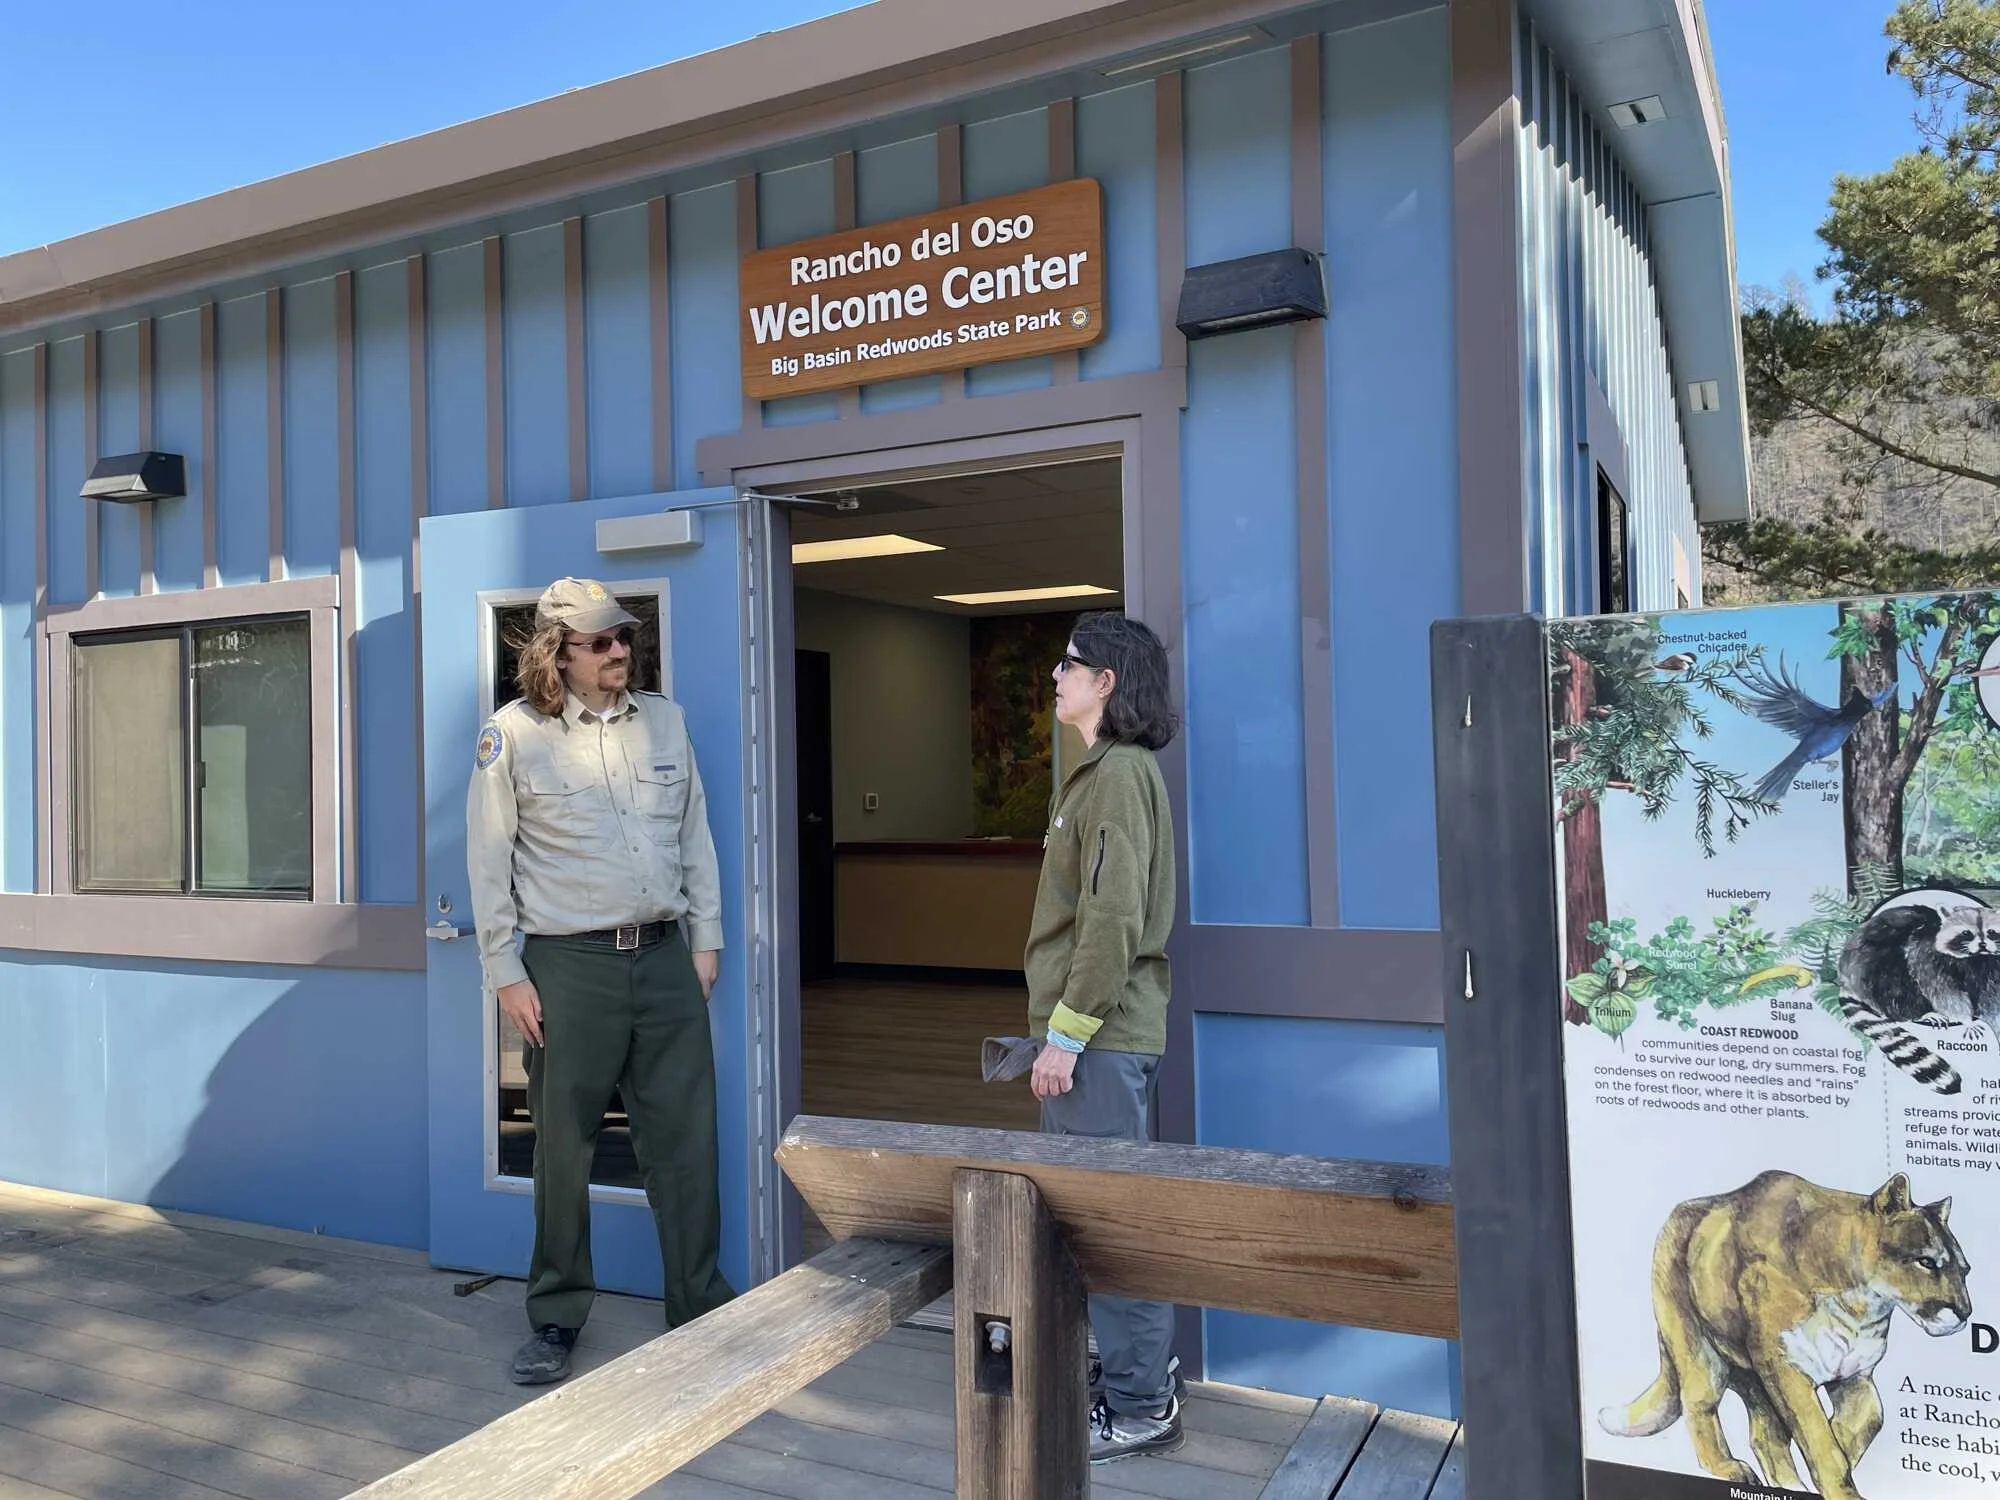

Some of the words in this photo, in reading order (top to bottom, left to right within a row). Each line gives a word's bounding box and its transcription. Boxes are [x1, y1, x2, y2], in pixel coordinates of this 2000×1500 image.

[790, 242, 901, 286] Rancho
[911, 222, 960, 261] del
[971, 214, 1034, 248] Oso
[750, 283, 928, 345] Welcome
[942, 250, 1087, 309] Center
[771, 357, 798, 376] Big
[804, 347, 851, 370] Basin
[857, 330, 952, 361] Redwoods
[957, 320, 1010, 344] State
[1015, 308, 1061, 333] Park
[1657, 629, 1747, 645] Chestnut-backed
[1697, 643, 1748, 653] Chicadee
[1793, 779, 1839, 790] Steller's
[1821, 791, 1839, 803] Jay
[1706, 888, 1771, 902] Huckleberry
[1648, 946, 1696, 959] Redwood
[1770, 999, 1813, 1010] Banana
[1771, 1011, 1796, 1023] Slug
[1700, 1026, 1737, 1037] COAST
[1740, 1028, 1799, 1040] REDWOOD
[1642, 1039, 1719, 1052] communities
[1722, 1042, 1769, 1056] depend
[1773, 1046, 1789, 1055] on
[1792, 1047, 1839, 1058] coastal
[1842, 1048, 1863, 1061] fog
[1937, 1040, 1988, 1052] Raccoon
[1635, 1053, 1646, 1062] to
[1649, 1054, 1692, 1065] survive
[1695, 1057, 1715, 1066] our
[1719, 1057, 1748, 1070] long,
[1752, 1059, 1772, 1071] dry
[1775, 1062, 1839, 1074] summers.
[1842, 1063, 1866, 1077] Fog
[1594, 1065, 1657, 1078] condenses
[1660, 1070, 1675, 1079] on
[1679, 1071, 1730, 1082] redwood
[1735, 1074, 1784, 1086] needles
[1787, 1078, 1811, 1088] and
[1981, 1076, 2000, 1088] ha
[1595, 1081, 1609, 1089] on
[1613, 1080, 1631, 1091] the
[1635, 1082, 1669, 1094] forest
[1671, 1084, 1702, 1097] floor,
[1705, 1087, 1743, 1099] where
[1746, 1089, 1754, 1099] it
[1758, 1090, 1768, 1100] is
[1772, 1090, 1831, 1105] absorbed
[1835, 1094, 1850, 1108] by
[1972, 1094, 1986, 1104] of
[1990, 1094, 2000, 1104] ri
[1595, 1095, 1625, 1106] roots
[1627, 1096, 1639, 1106] of
[1642, 1098, 1700, 1111] redwoods
[1703, 1102, 1726, 1112] and
[1730, 1104, 1762, 1115] other
[1766, 1107, 1809, 1119] plants.
[1904, 1107, 1959, 1119] streams
[1905, 1123, 1947, 1136] refuge
[1951, 1125, 1969, 1135] for
[1905, 1140, 1962, 1152] animals.
[1906, 1154, 1960, 1167] habitats
[1964, 1159, 1992, 1171] may
[1899, 1375, 1917, 1393] A
[1923, 1383, 1992, 1401] mosaic
[1900, 1406, 1918, 1419] at
[1924, 1404, 2000, 1429] Rancho
[1900, 1428, 1951, 1449] these
[1957, 1434, 2000, 1455] habi
[1900, 1453, 1932, 1472] the
[1938, 1462, 1986, 1483] cool,
